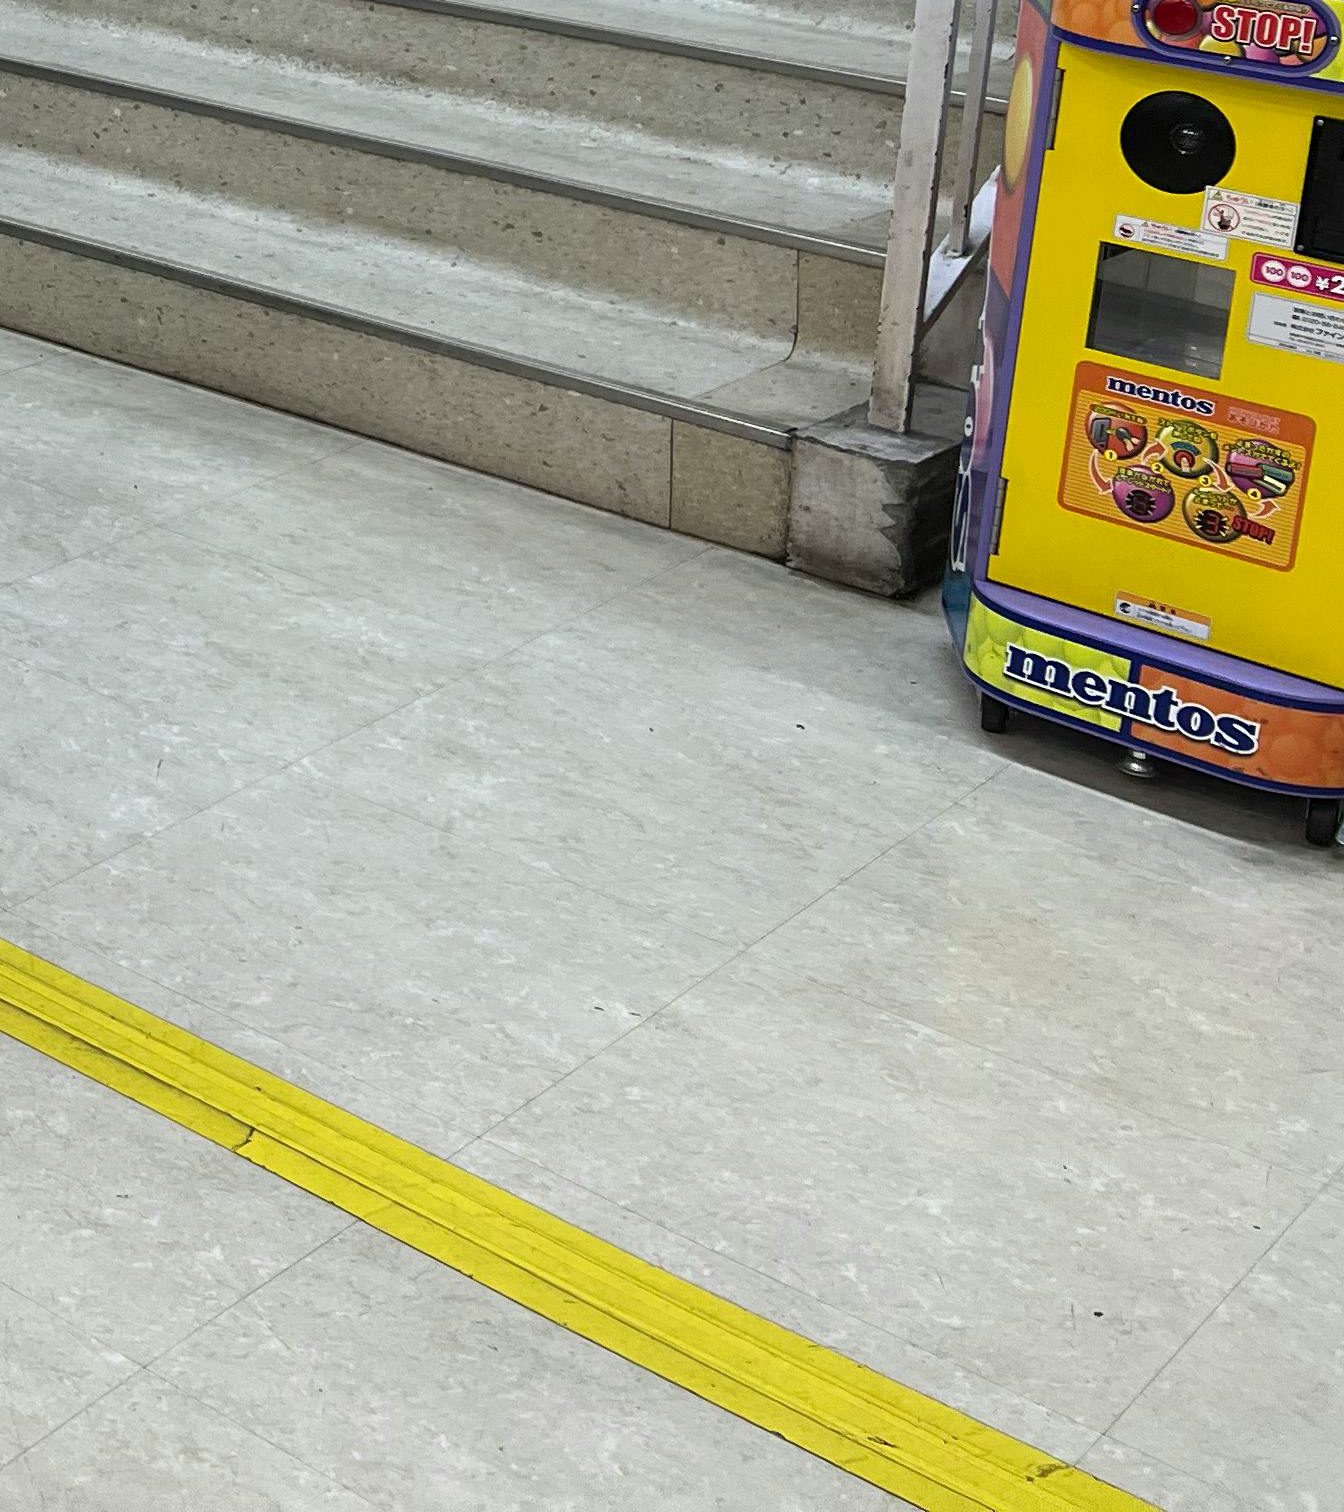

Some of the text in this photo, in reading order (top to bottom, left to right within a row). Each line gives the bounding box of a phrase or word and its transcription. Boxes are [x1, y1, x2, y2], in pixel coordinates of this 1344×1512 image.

[1211, 4, 1318, 55] STOP!
[1105, 374, 1216, 417] mentos
[1004, 642, 1261, 756] mentos
